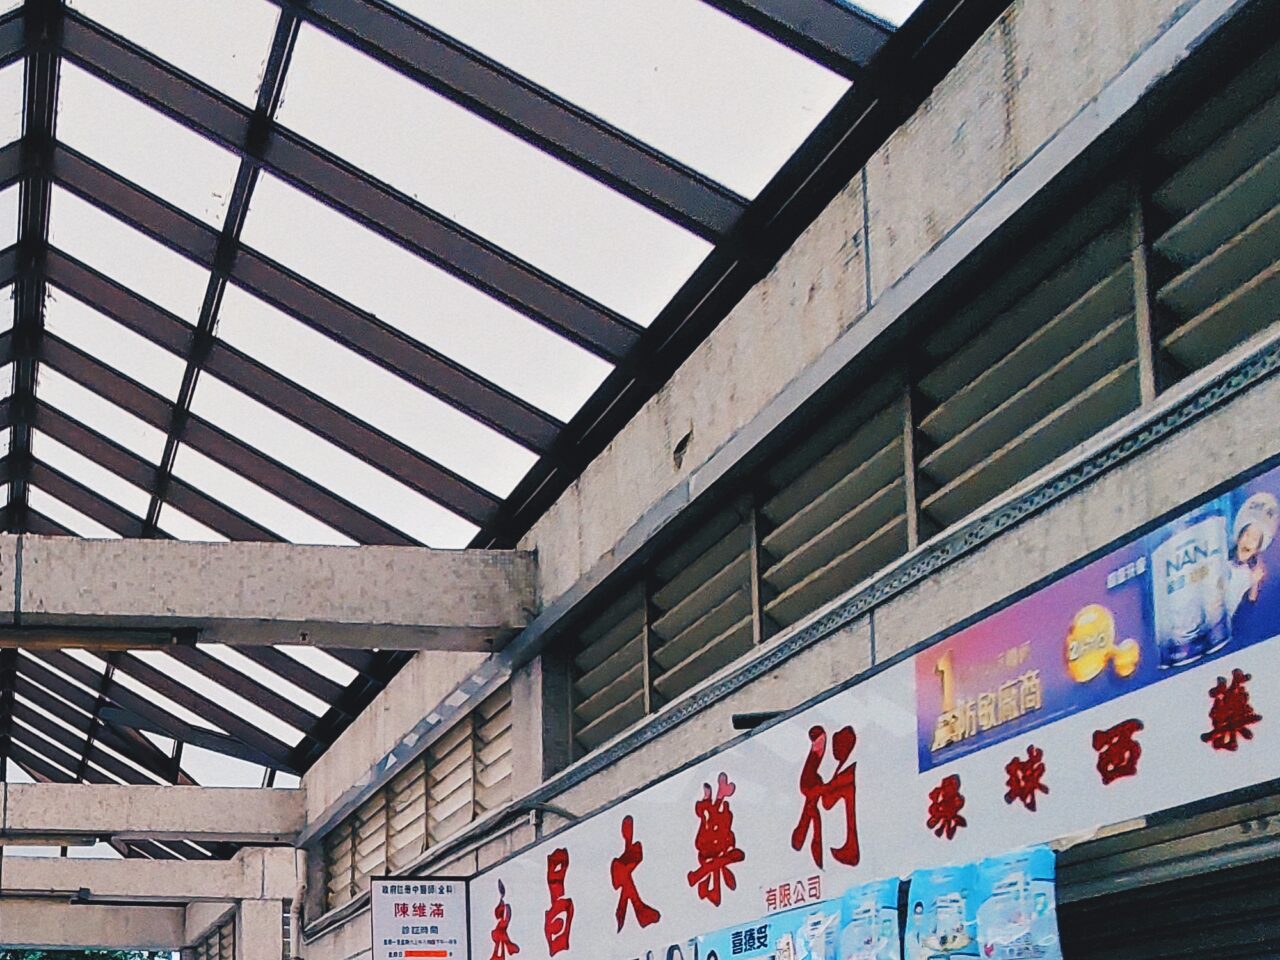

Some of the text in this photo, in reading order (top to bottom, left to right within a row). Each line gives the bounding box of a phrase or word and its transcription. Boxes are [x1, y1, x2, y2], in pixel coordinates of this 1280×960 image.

[1165, 545, 1209, 577] NAN
[764, 875, 821, 911] 有限公司
[394, 902, 444, 918] 陳維滿
